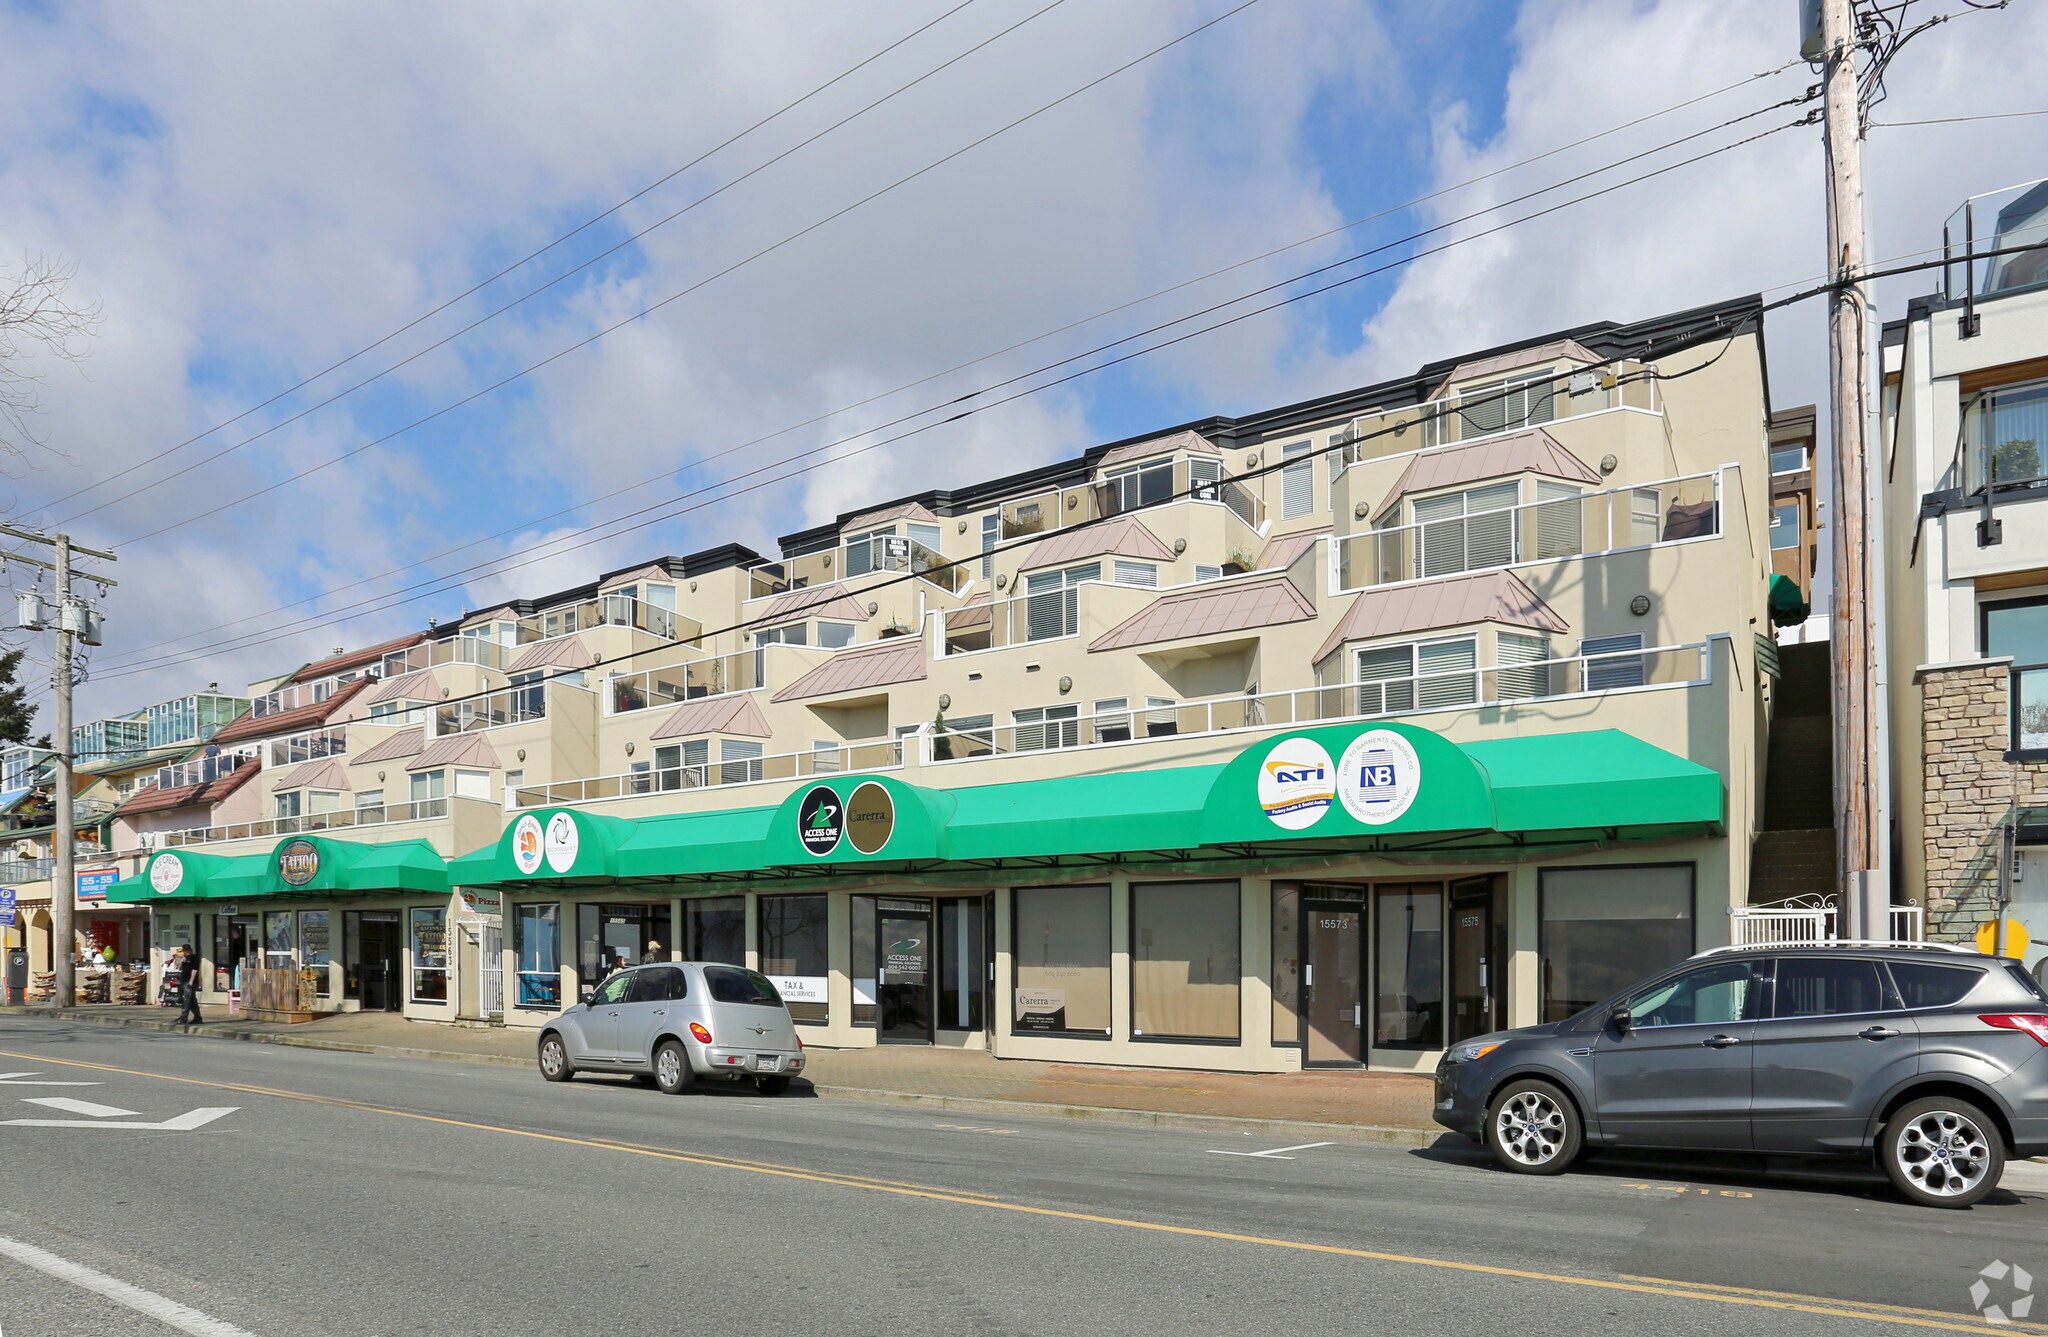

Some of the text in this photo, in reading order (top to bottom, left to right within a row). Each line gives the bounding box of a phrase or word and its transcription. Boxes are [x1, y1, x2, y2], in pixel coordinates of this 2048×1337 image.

[1343, 758, 1351, 776] FIBRE
[1350, 750, 1357, 758] TO
[1357, 737, 1389, 751] GARMENTS
[1390, 739, 1411, 760] TRADING
[1365, 766, 1392, 787] NB
[1343, 788, 1355, 808] NAEEM
[1354, 805, 1386, 818] BROTHERS
[1386, 797, 1407, 816] CANADA
[1404, 786, 1412, 798] INC
[804, 828, 838, 838] ACCESS ONE
[162, 855, 179, 869] CREAM
[280, 853, 318, 875] TATTOO
[478, 897, 501, 906] Pizza
[1319, 919, 1348, 930] 15573
[1461, 916, 1479, 927] 15575
[784, 981, 804, 990] TAX &
[1020, 995, 1049, 1005] Carerra
